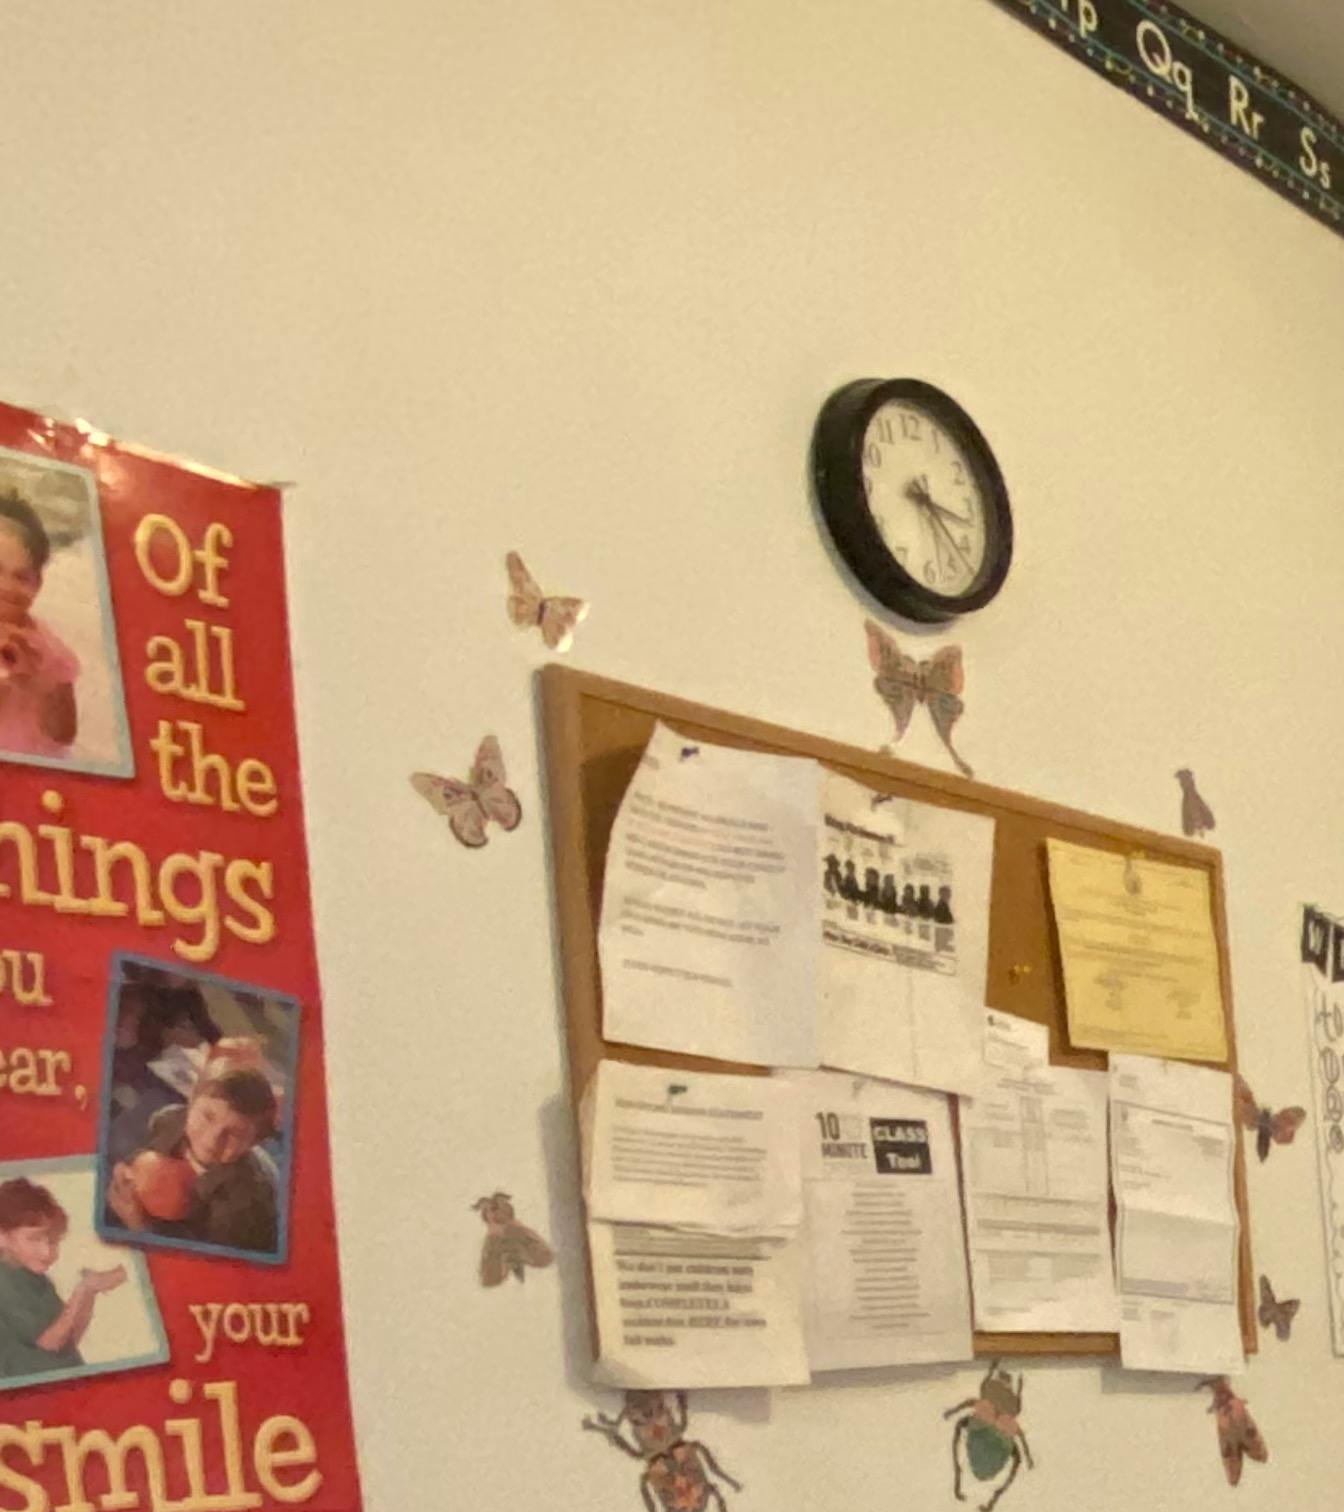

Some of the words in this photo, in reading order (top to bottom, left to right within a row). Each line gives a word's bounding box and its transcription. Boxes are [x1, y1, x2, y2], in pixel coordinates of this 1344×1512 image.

[1060, 0, 1098, 38] p
[1136, 20, 1199, 120] Qq
[1229, 75, 1264, 141] Rr
[1299, 127, 1331, 189] Ss
[901, 414, 923, 442] 12
[134, 513, 234, 609] Of
[144, 617, 246, 711] all
[149, 718, 279, 817] the
[1311, 988, 1344, 1044] to
[815, 1111, 841, 1141] 10
[821, 1142, 868, 1159] MINUTE
[873, 1126, 927, 1143] CLASS
[189, 1301, 312, 1363] your
